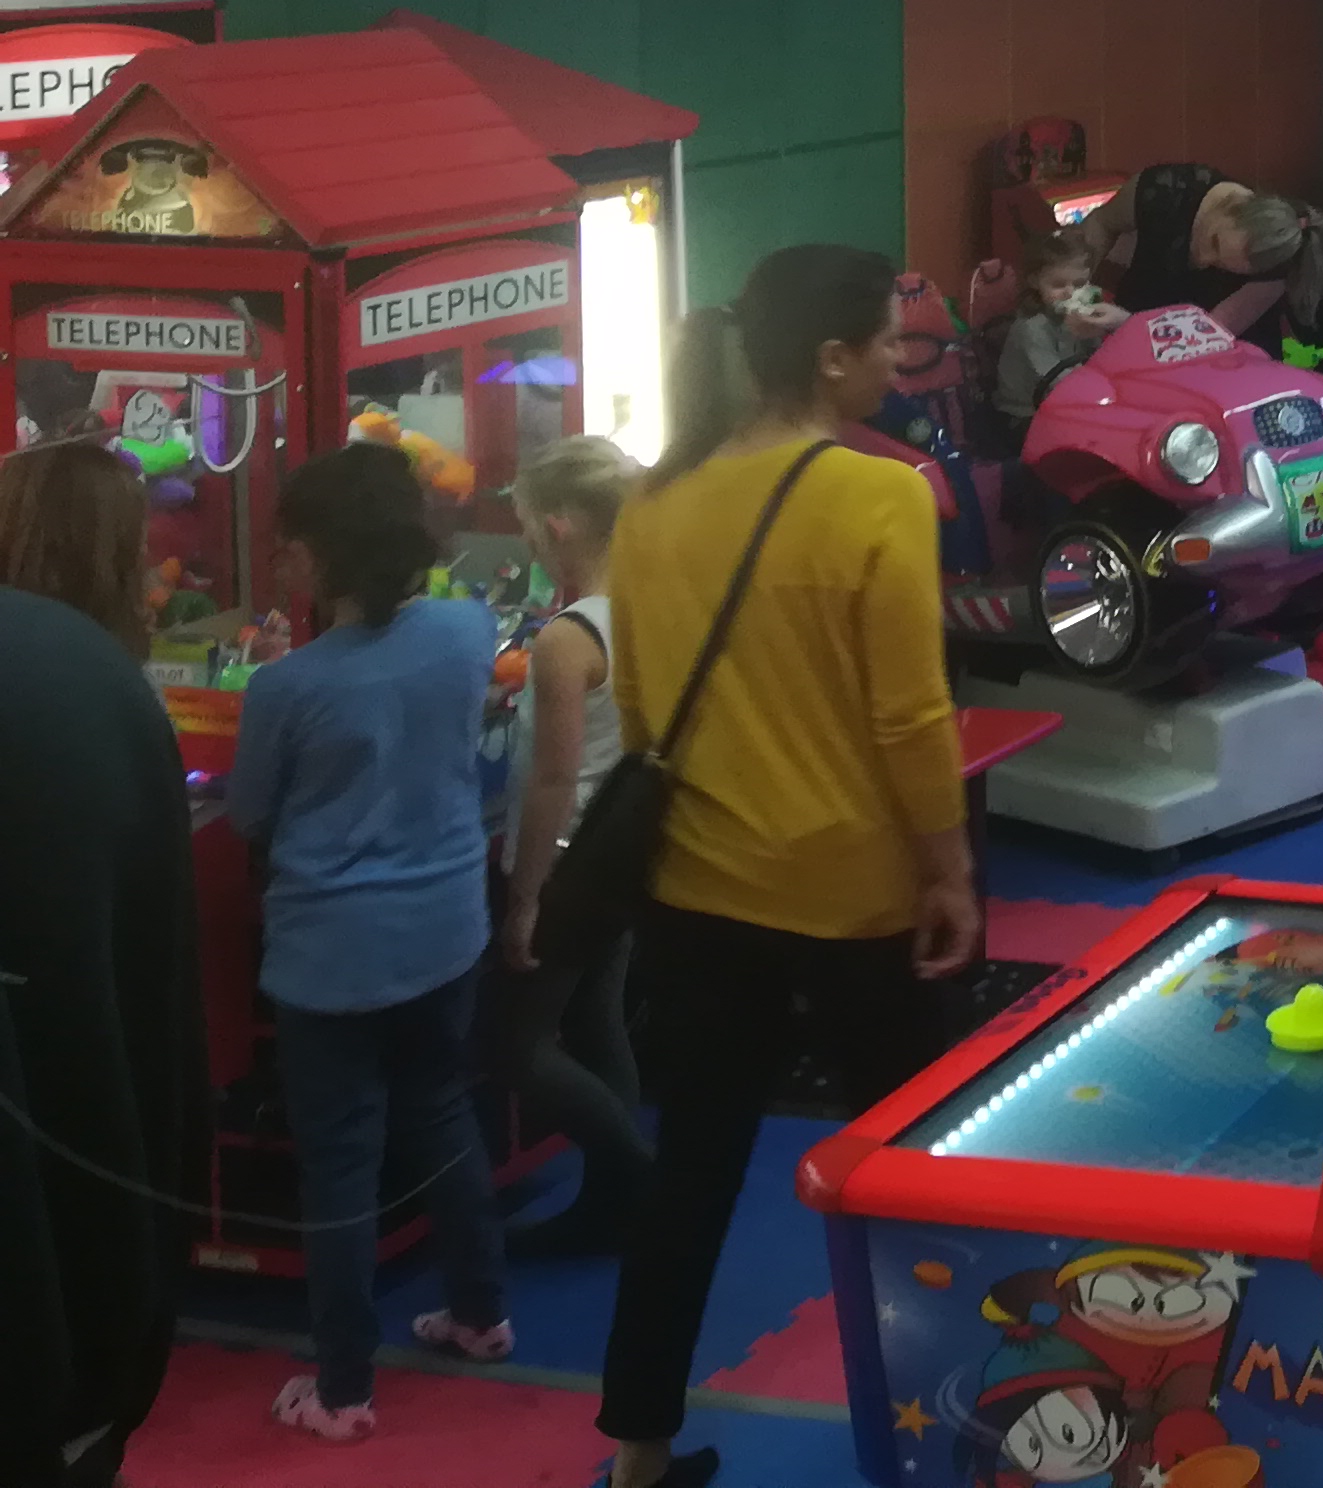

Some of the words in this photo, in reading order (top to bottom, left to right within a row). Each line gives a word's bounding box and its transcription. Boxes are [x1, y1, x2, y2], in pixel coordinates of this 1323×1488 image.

[61, 211, 174, 235] TELEPHONE
[366, 267, 566, 337] TELEPHONE
[52, 316, 243, 352] TELEPHONE
